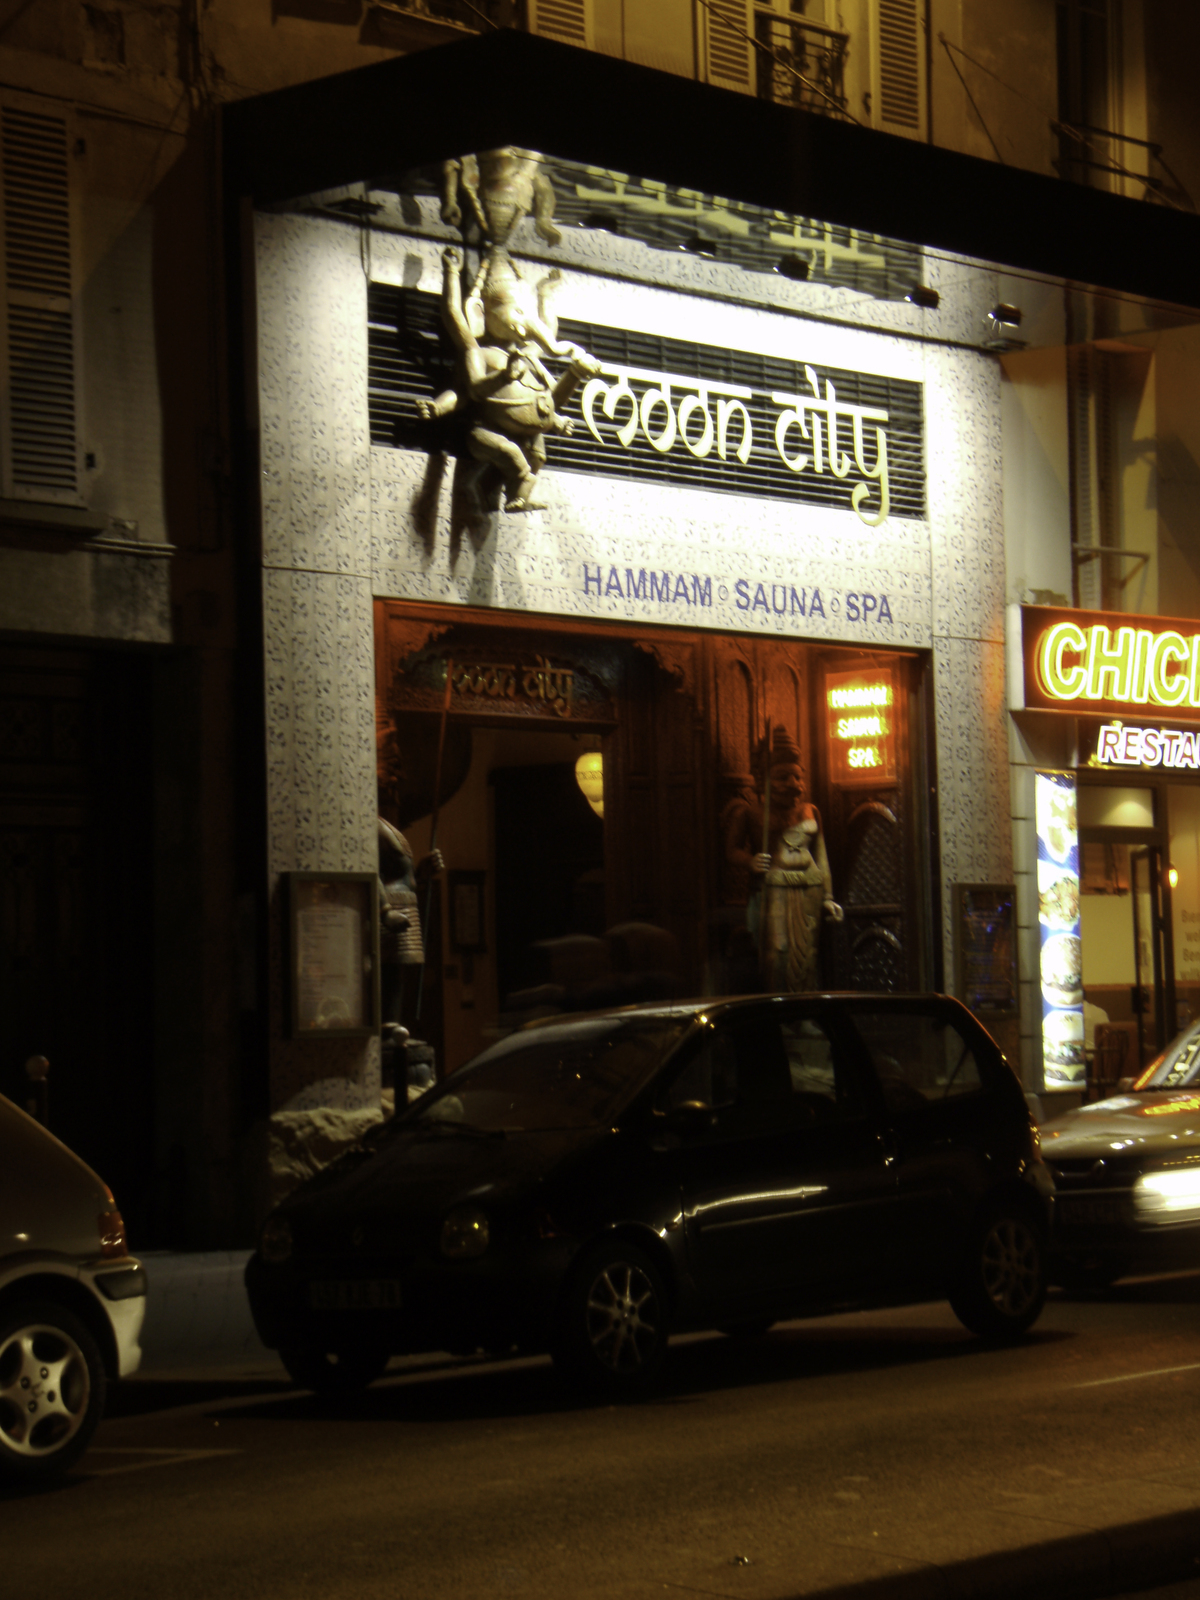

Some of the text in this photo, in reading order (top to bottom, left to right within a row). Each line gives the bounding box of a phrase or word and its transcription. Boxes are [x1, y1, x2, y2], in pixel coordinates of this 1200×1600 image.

[582, 362, 890, 526] moon city
[583, 564, 894, 623] HAMMAM SAUNA SPA
[522, 653, 574, 717] city
[1037, 620, 1200, 708] CHIC
[847, 746, 878, 768] SPA
[1096, 724, 1200, 769] RESTA
